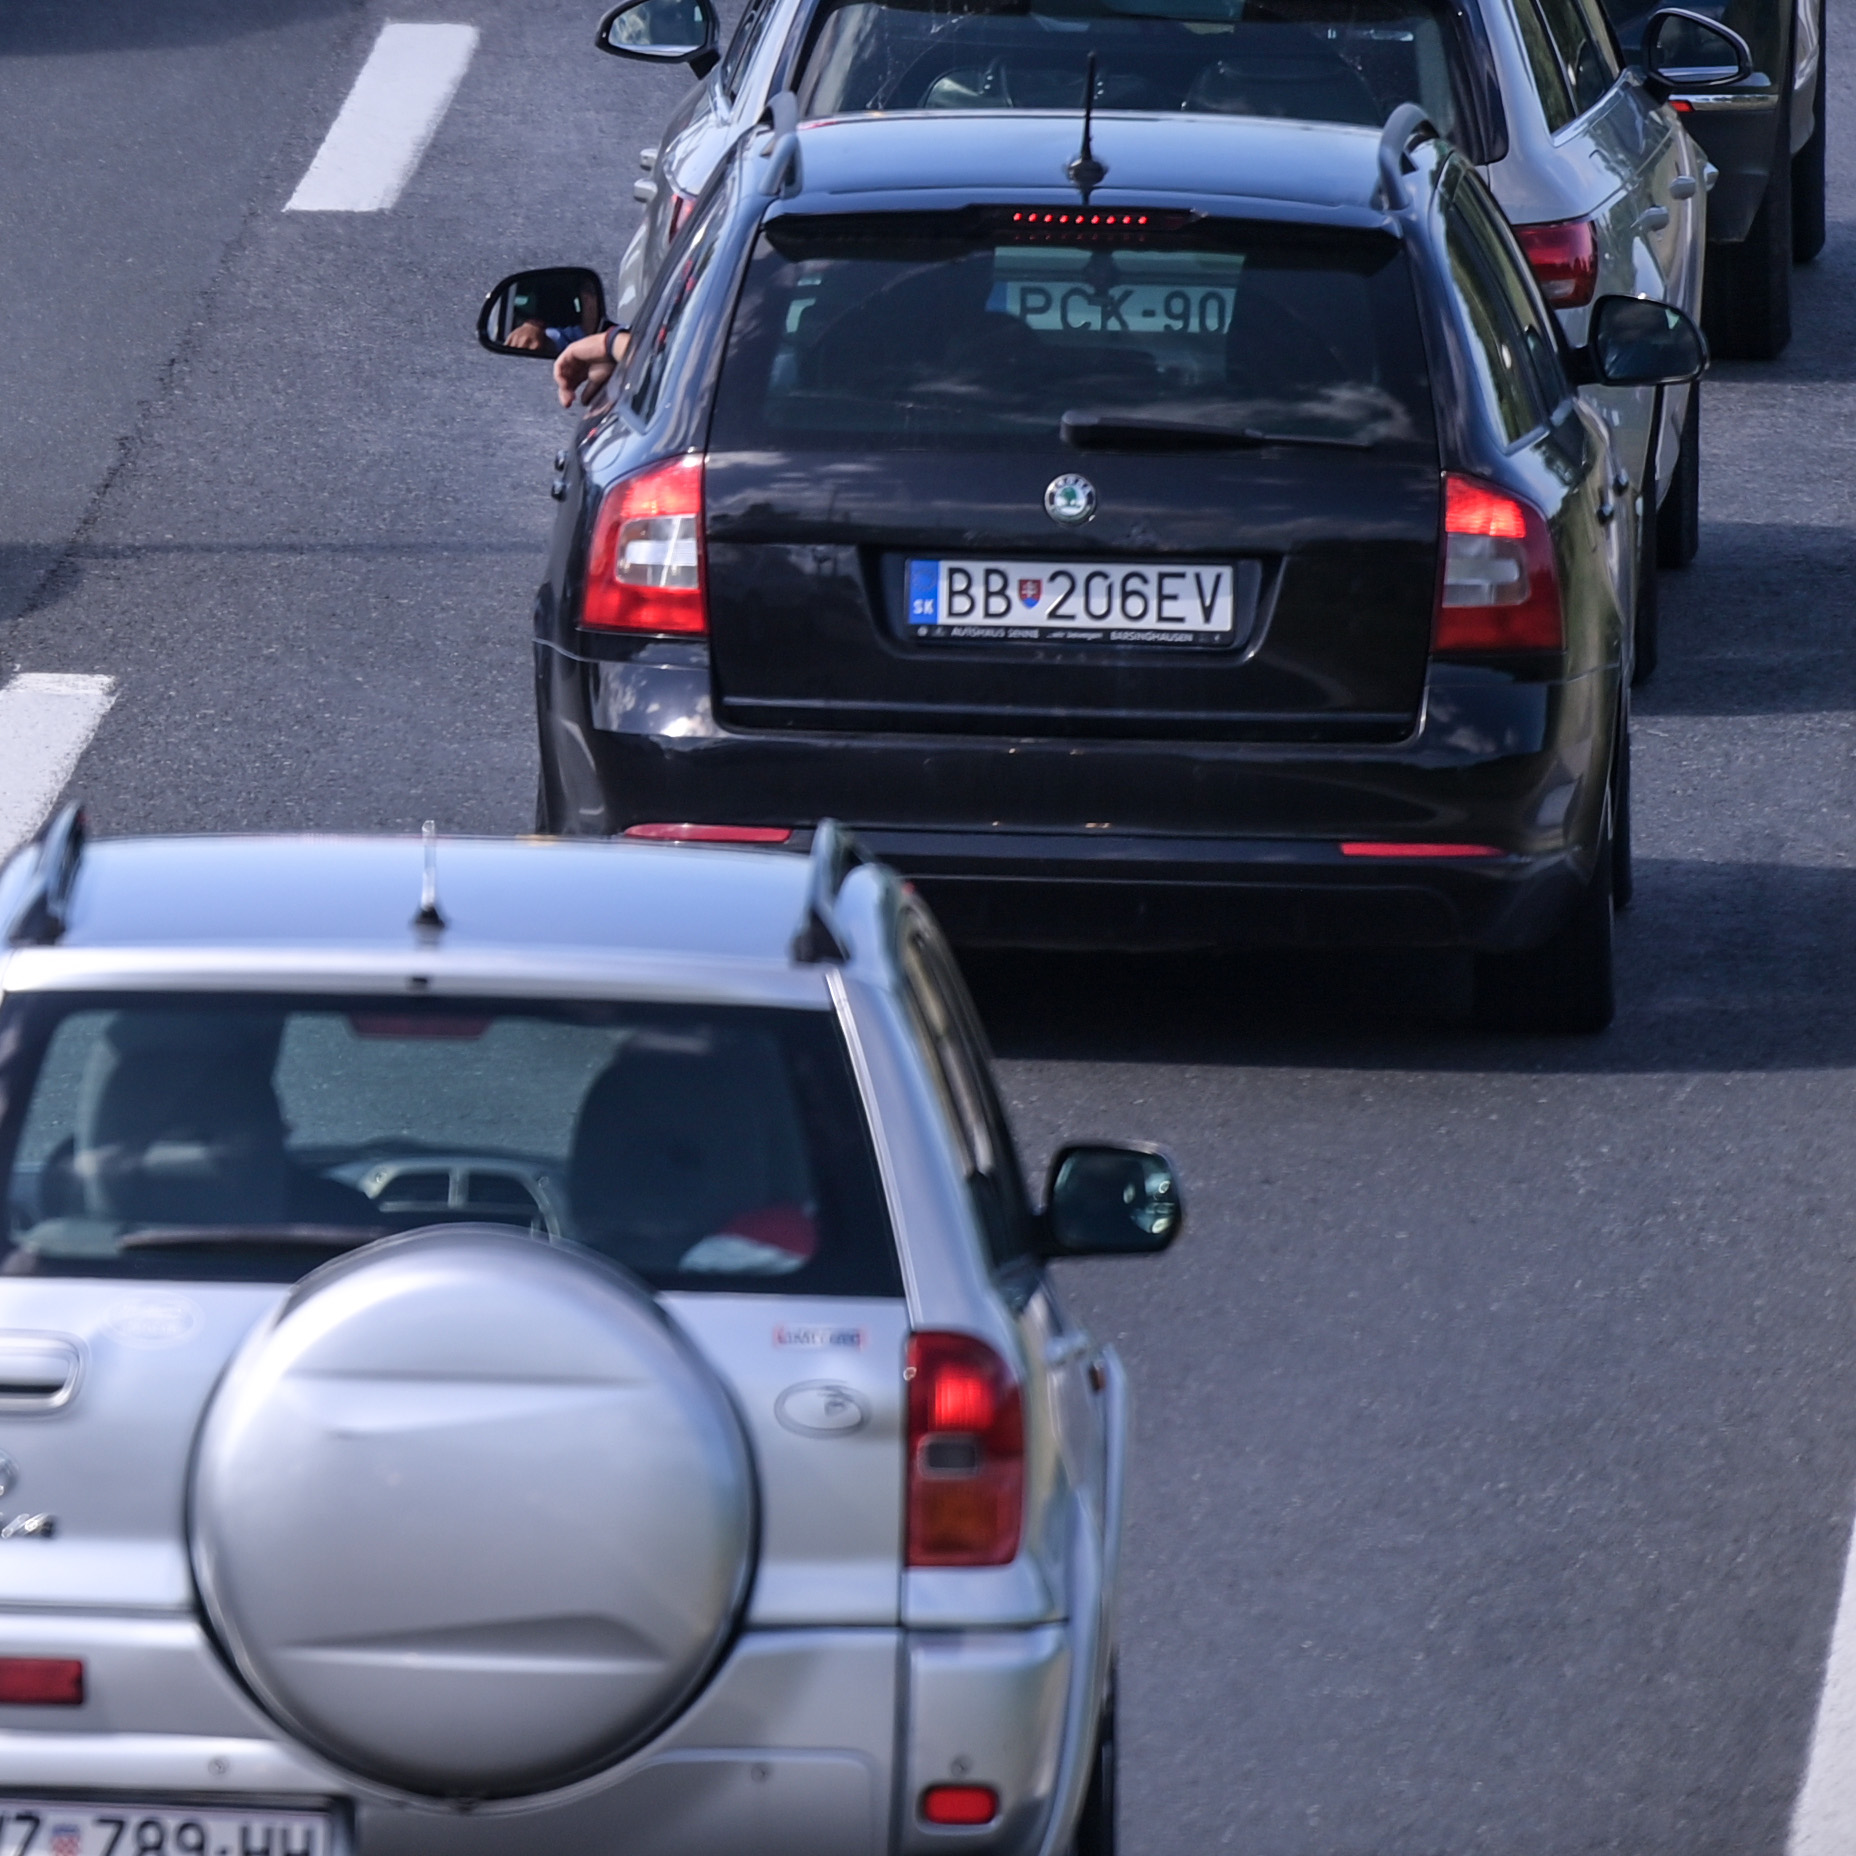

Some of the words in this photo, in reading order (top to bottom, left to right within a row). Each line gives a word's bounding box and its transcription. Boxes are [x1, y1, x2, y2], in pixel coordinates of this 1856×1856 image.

[912, 600, 935, 615] SK
[946, 567, 1013, 621] BB
[1044, 569, 1224, 626] 206EV
